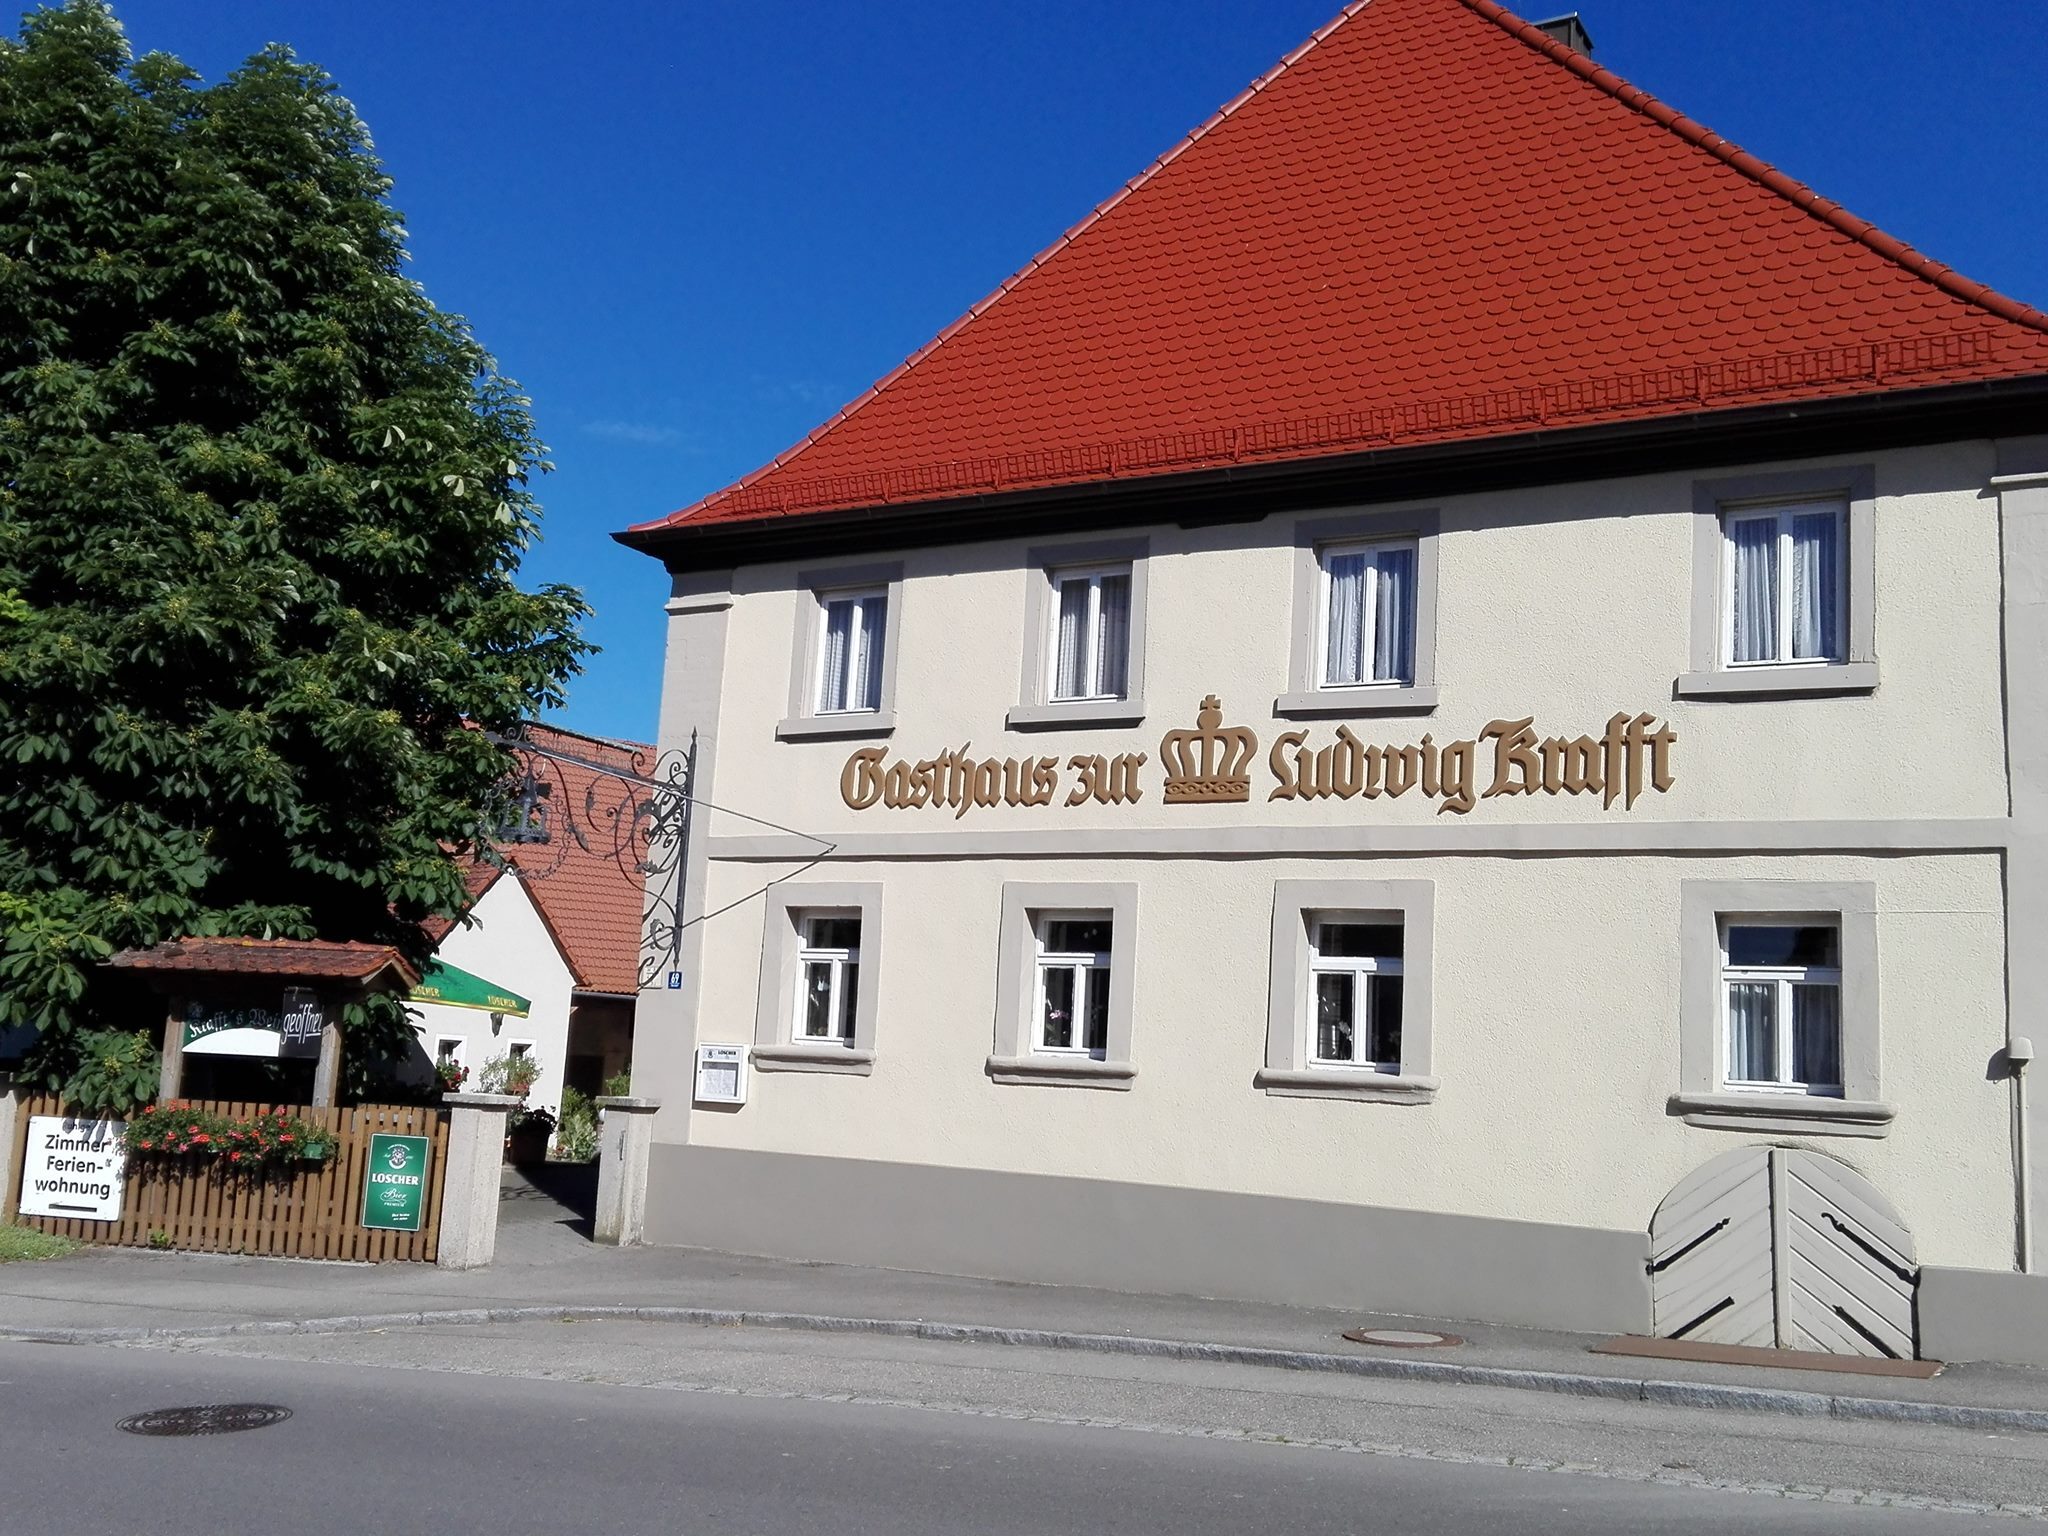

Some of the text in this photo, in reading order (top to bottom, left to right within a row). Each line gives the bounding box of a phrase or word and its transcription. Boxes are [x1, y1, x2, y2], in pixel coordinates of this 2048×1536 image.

[1267, 711, 1677, 815] Ludwig Krafft
[840, 741, 1148, 820] Gasthaus zur
[671, 973, 680, 984] 69
[45, 1134, 108, 1153] Zimmer
[46, 1155, 103, 1173] Ferien-
[35, 1177, 110, 1200] wohnung
